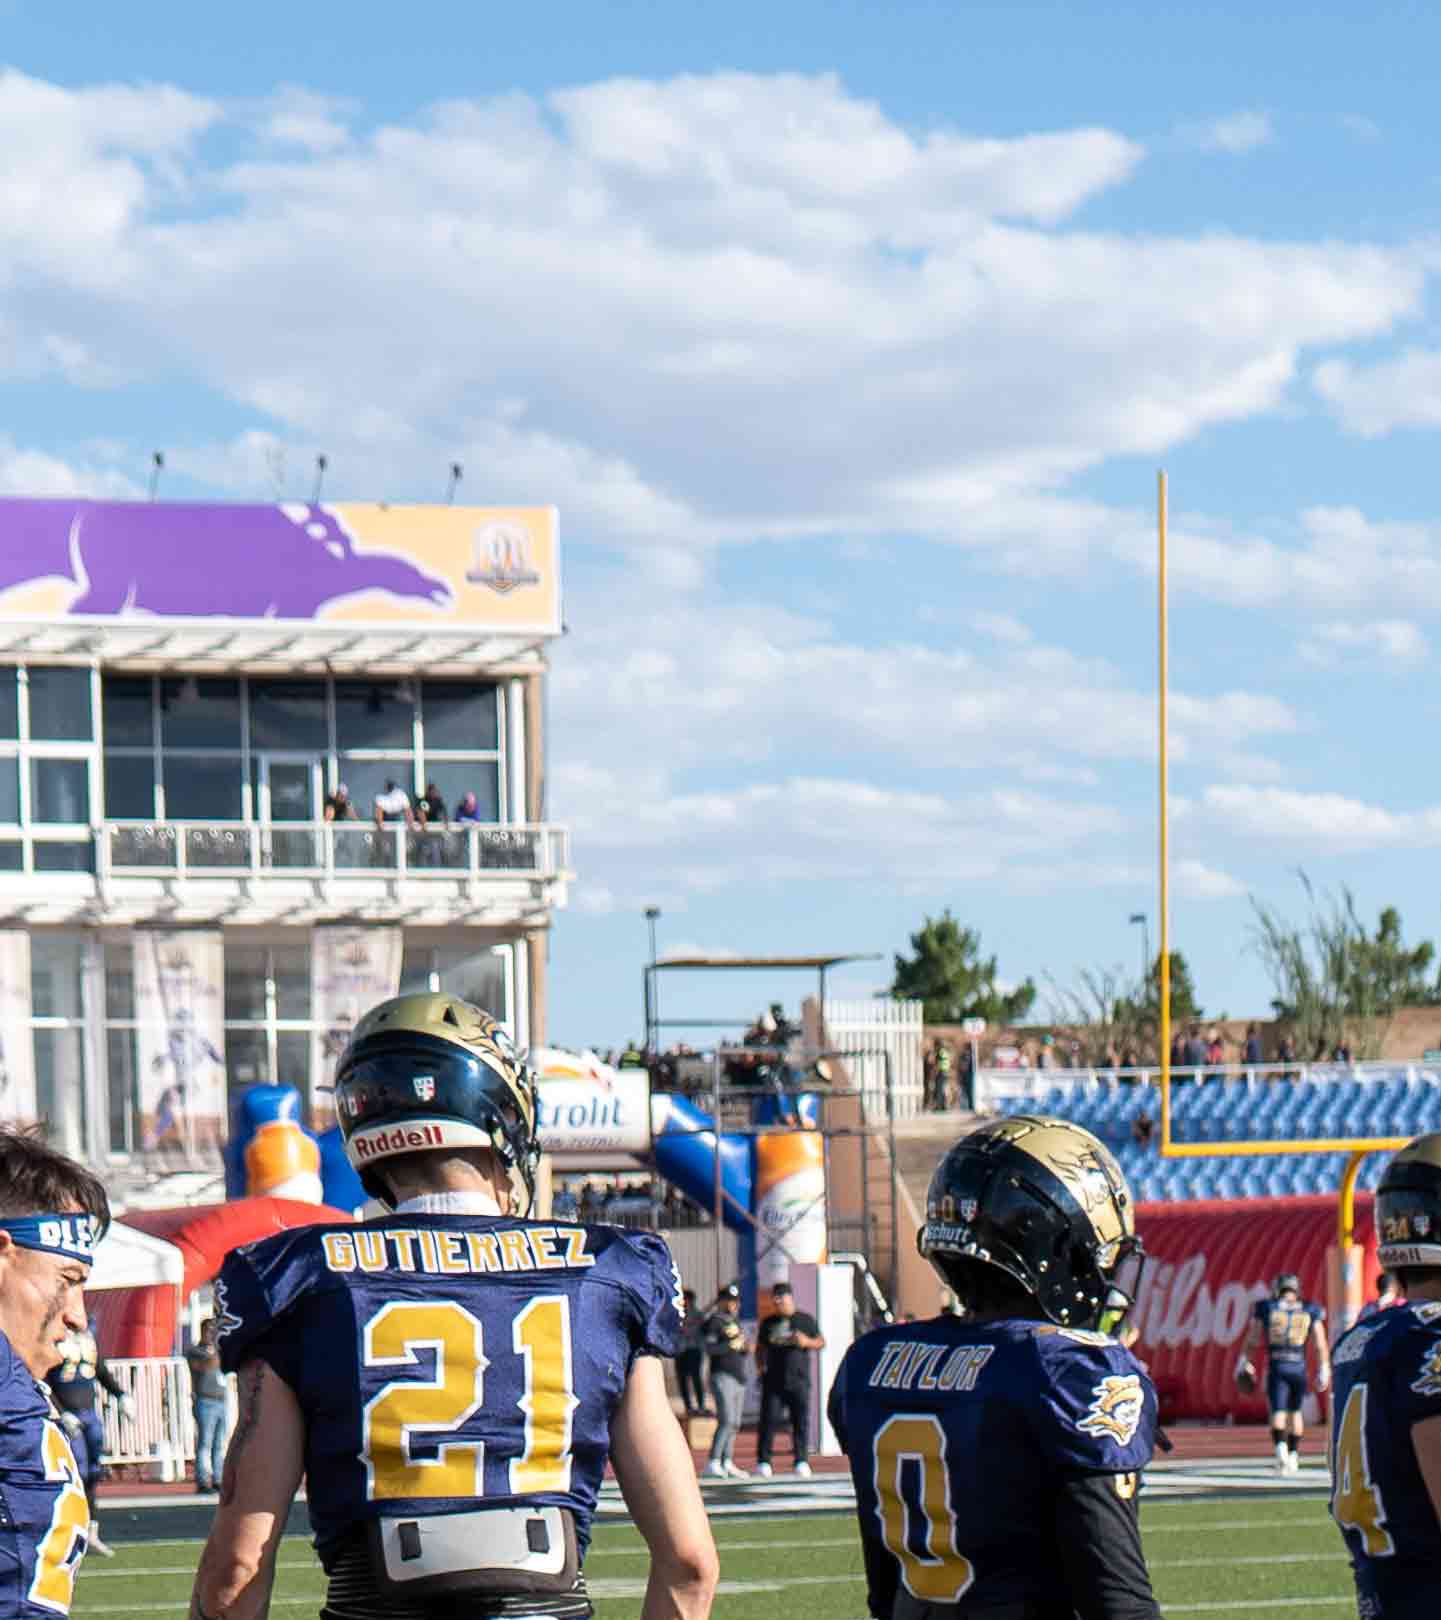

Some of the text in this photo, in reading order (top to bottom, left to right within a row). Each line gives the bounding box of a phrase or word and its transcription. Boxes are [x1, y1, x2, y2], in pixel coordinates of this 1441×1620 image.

[354, 1125, 444, 1160] Riddell
[321, 1226, 597, 1274] GUTIERREZ
[868, 1341, 996, 1392] TAYLOR
[362, 1295, 580, 1502] 21
[872, 1412, 975, 1604] 0
